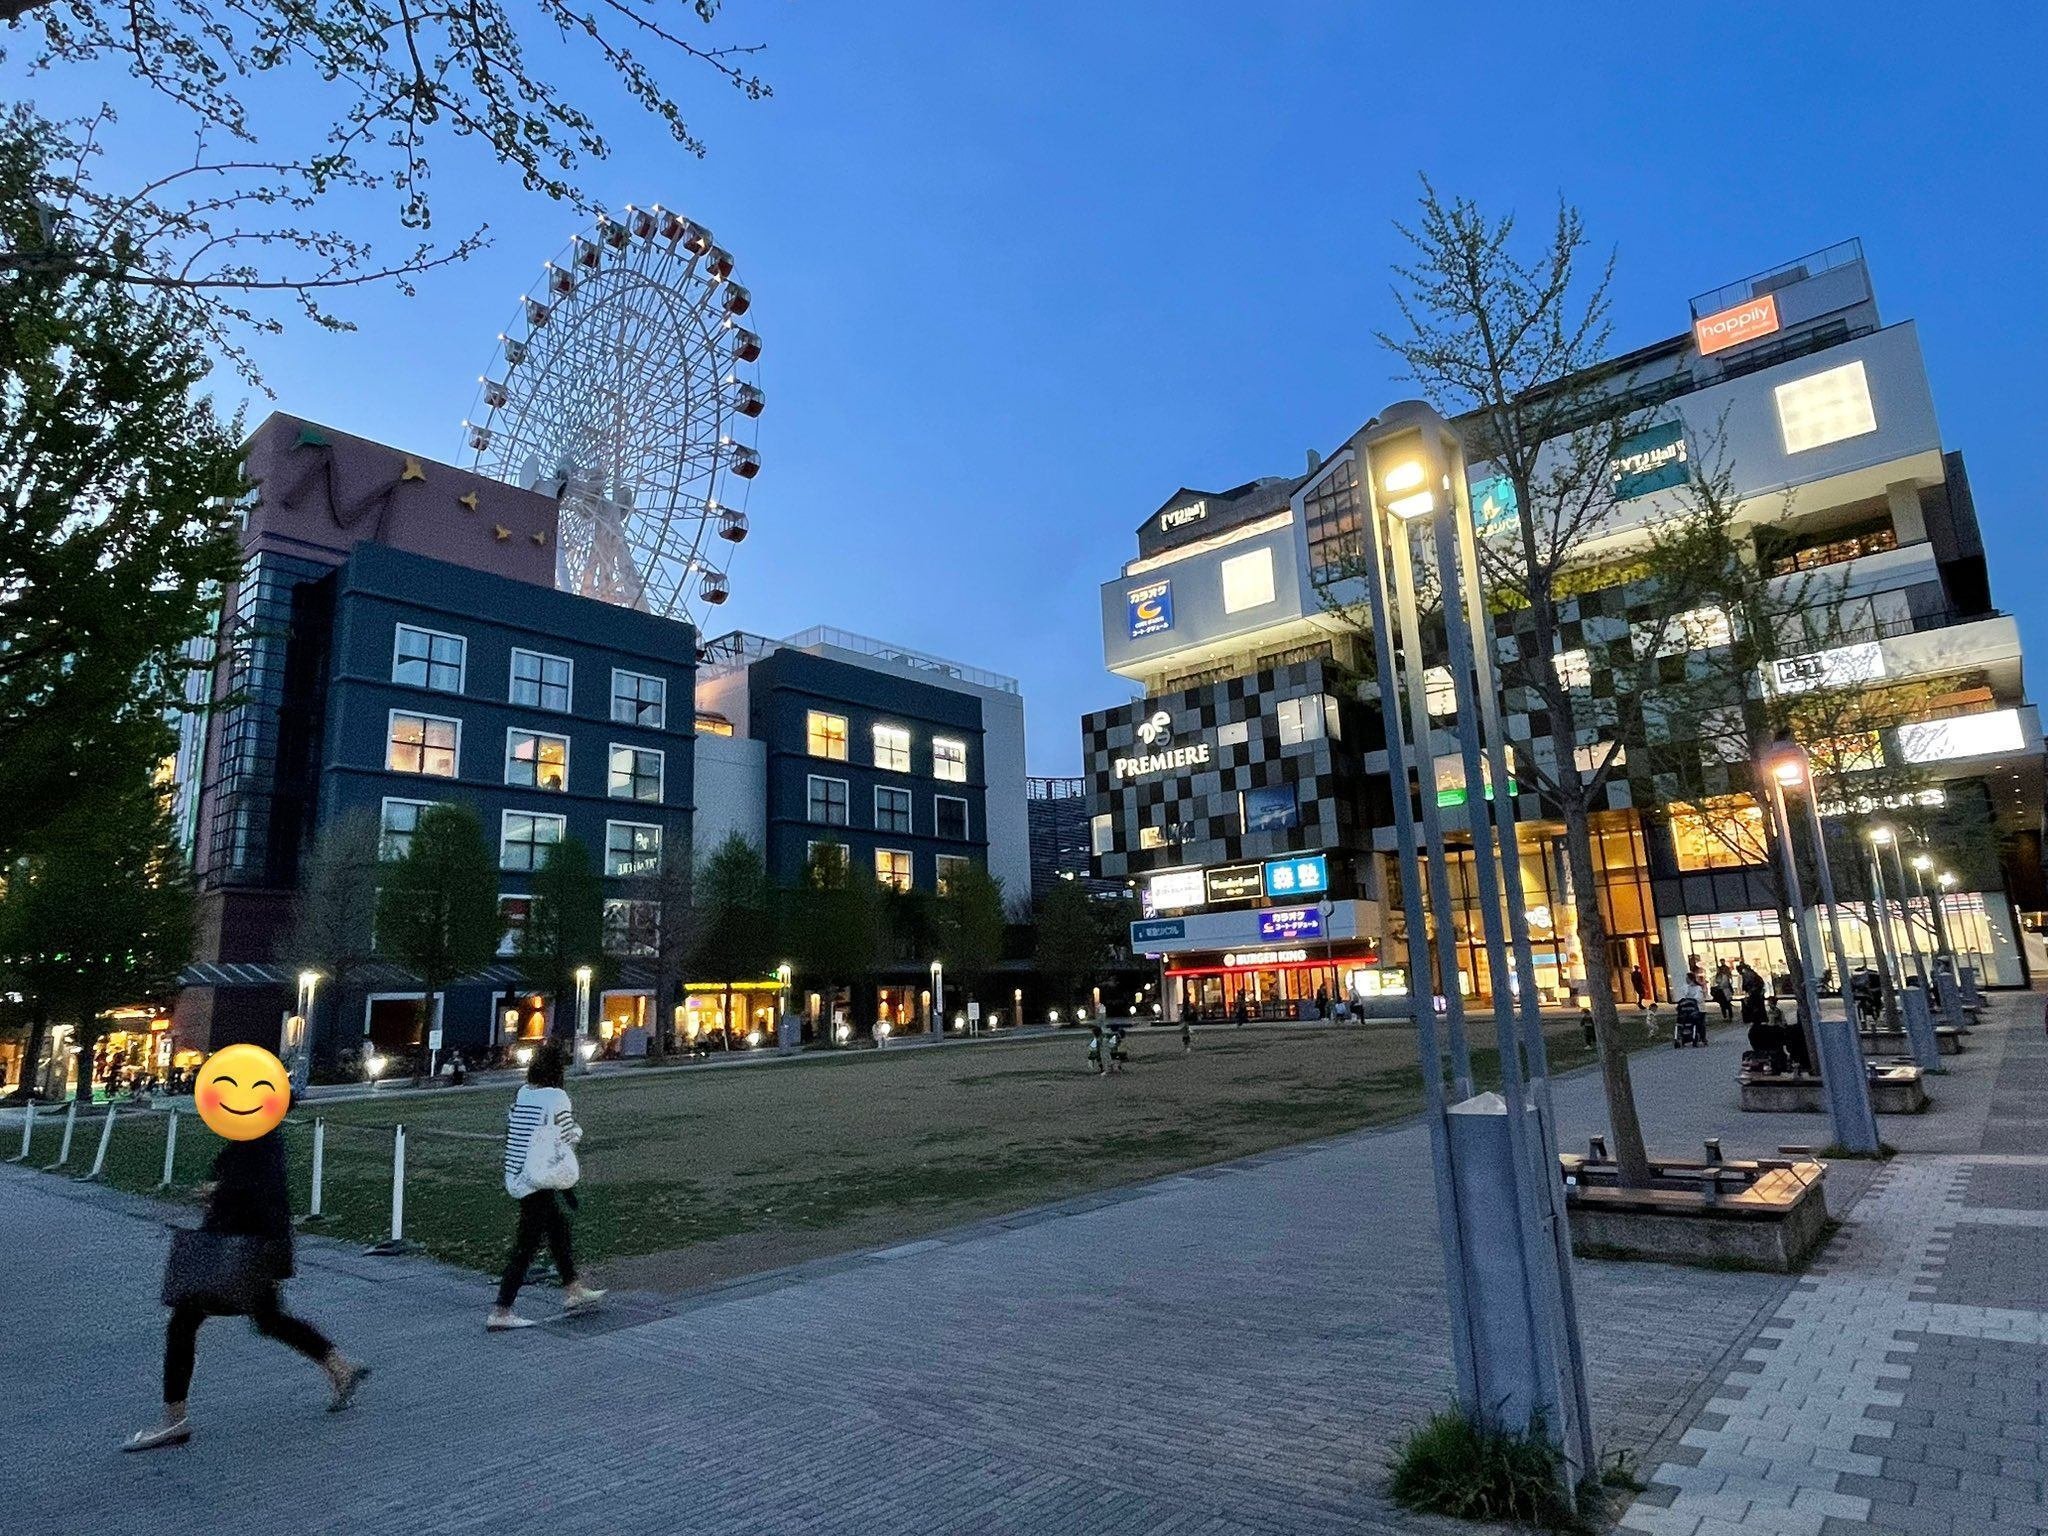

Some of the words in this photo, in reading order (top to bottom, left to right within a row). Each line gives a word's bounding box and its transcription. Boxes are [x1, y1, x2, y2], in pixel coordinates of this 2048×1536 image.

[1701, 304, 1770, 337] happily
[1130, 585, 1167, 604] カラオケ
[1114, 743, 1210, 779] PREMIERE
[1272, 911, 1306, 922] カラオケ
[1278, 949, 1307, 962] KING
